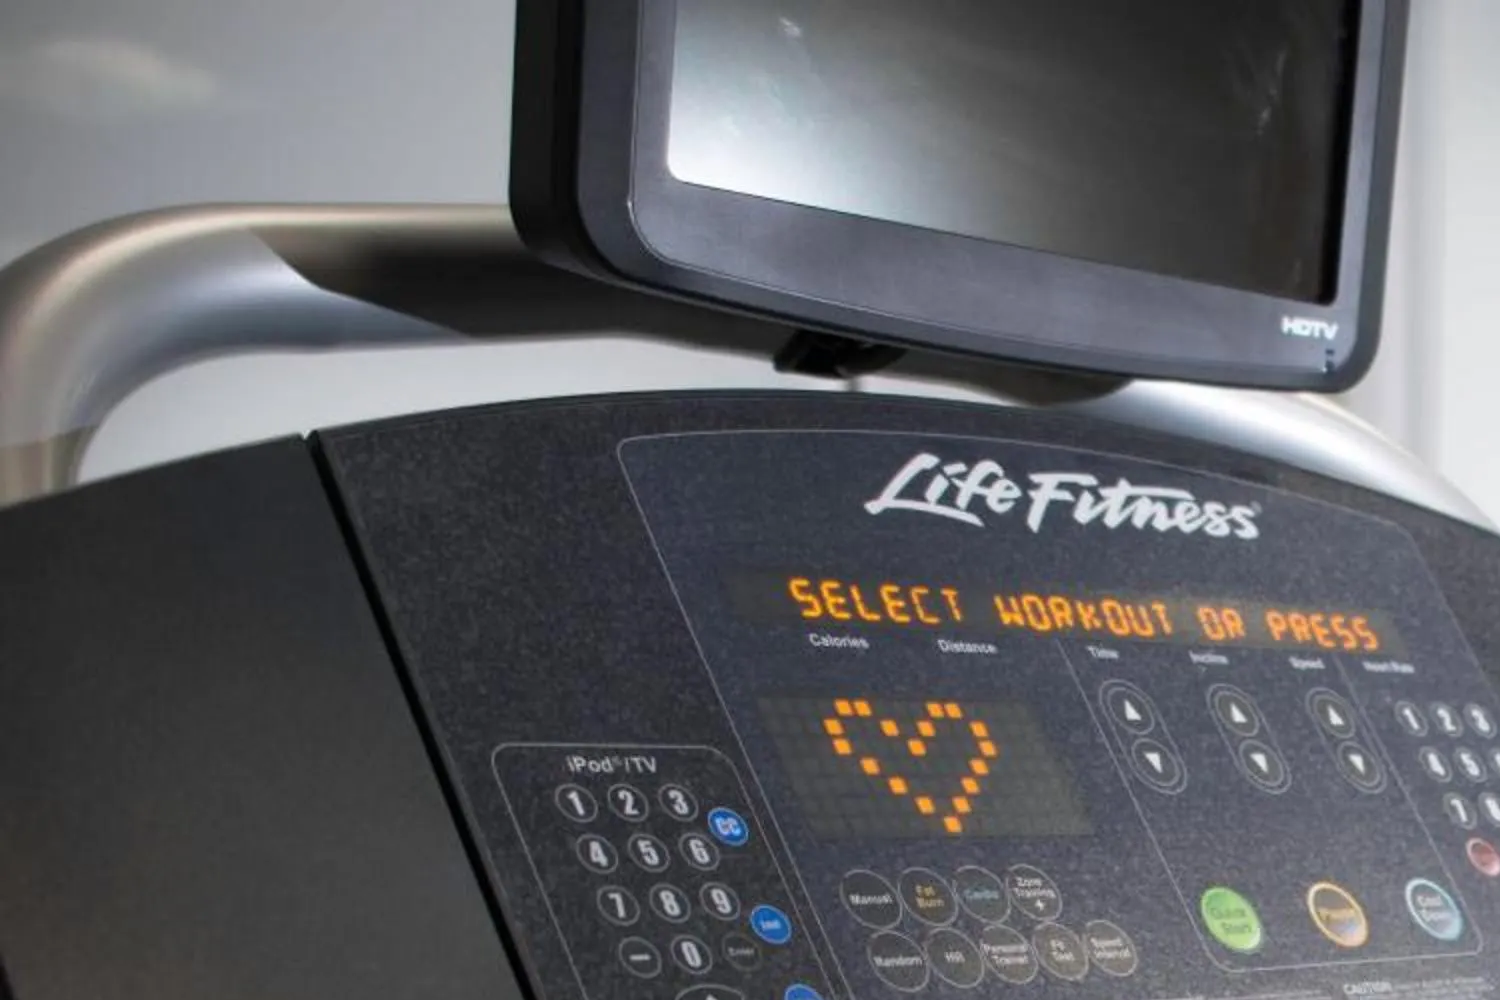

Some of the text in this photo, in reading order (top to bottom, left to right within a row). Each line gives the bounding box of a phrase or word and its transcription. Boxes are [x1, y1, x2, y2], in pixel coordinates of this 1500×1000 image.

[1281, 315, 1338, 340] HDTV
[864, 453, 1259, 539] Life Fitness
[790, 577, 1379, 651] SELECT WORKOUT OR PRESS
[808, 632, 869, 649] Calories
[937, 639, 999, 654] Distance
[1403, 708, 1420, 730] 1
[1437, 708, 1457, 730] 2
[568, 790, 585, 816] 1
[620, 790, 639, 816] 2
[669, 789, 689, 815] 3
[1450, 799, 1468, 822] 7
[589, 841, 608, 867] 4
[640, 839, 658, 865] 5
[690, 839, 710, 865] 6
[608, 892, 627, 919] 7
[660, 890, 681, 917] 8
[711, 889, 730, 915] 9
[682, 941, 702, 967] 0
